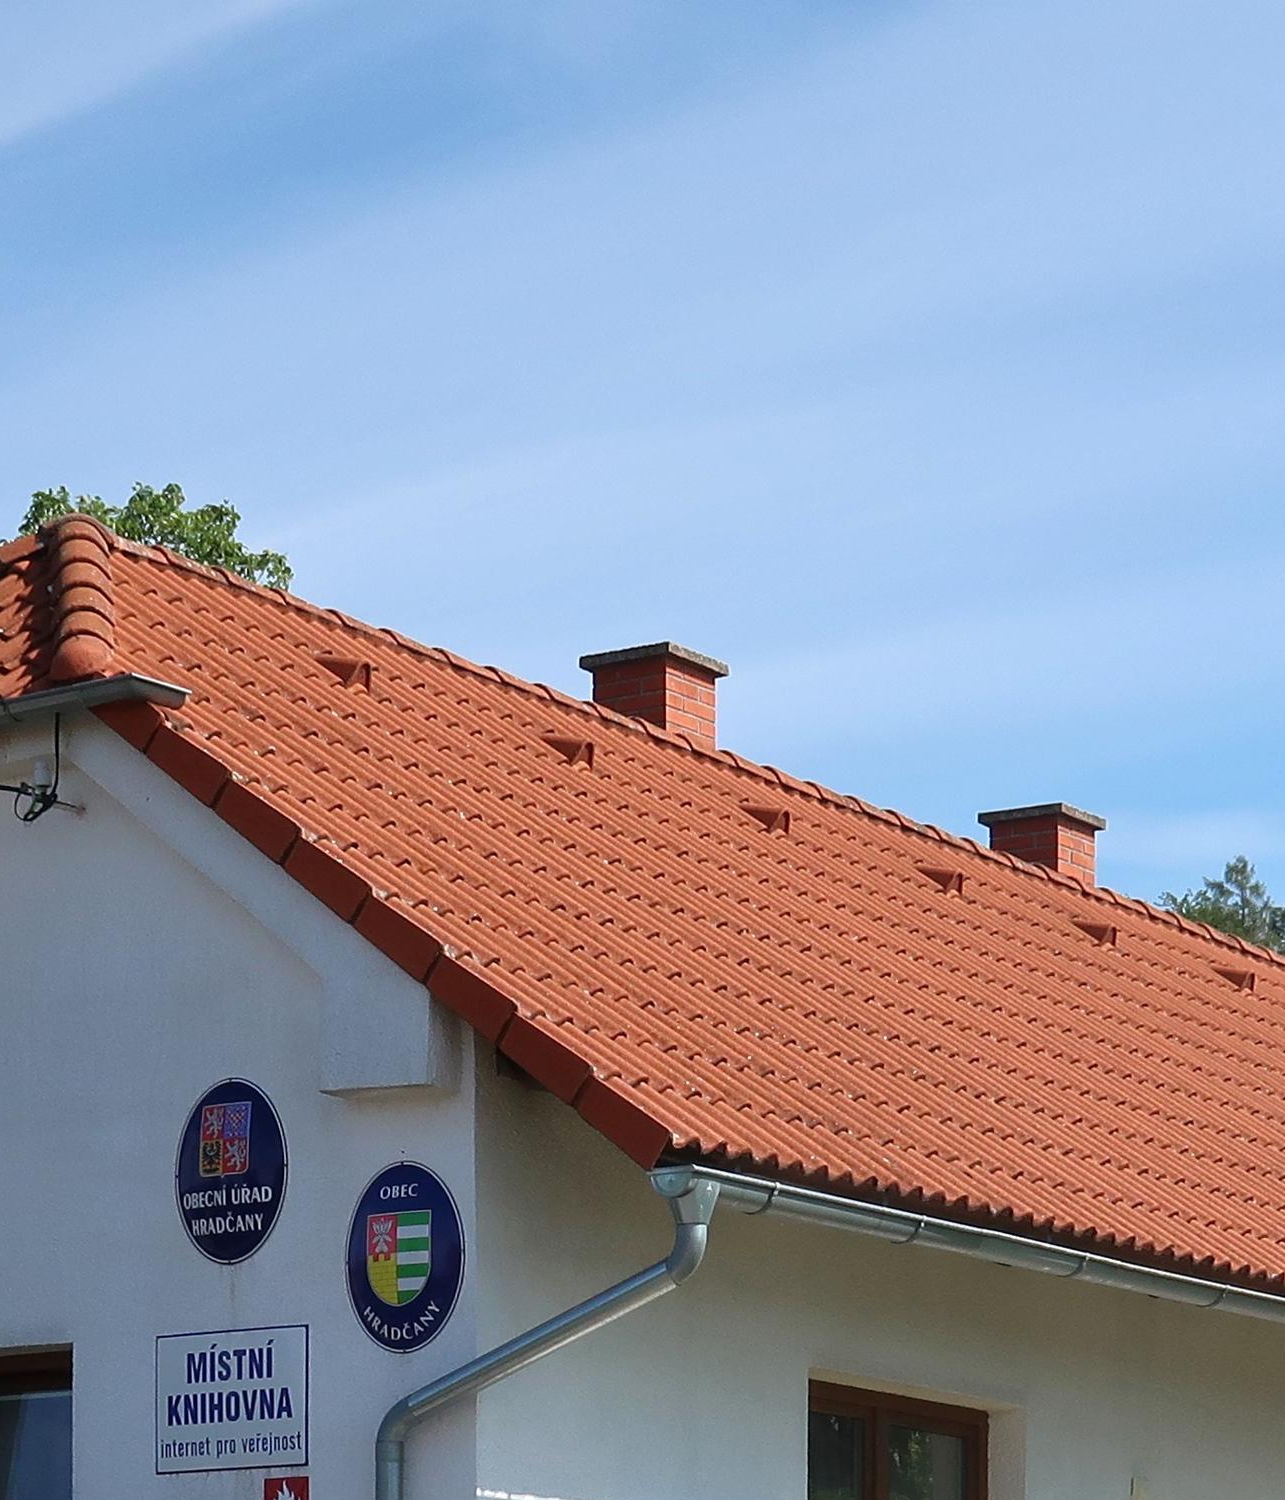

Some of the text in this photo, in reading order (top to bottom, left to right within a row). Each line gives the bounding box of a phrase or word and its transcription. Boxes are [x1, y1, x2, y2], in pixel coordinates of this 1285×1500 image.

[183, 1183, 273, 1209] OBECNÍ ÚŘAD
[380, 1183, 419, 1200] OBEC
[191, 1211, 264, 1236] HRADČANY
[363, 1301, 442, 1341] HRADČANY
[186, 1338, 275, 1384] MÍSTNÍ
[167, 1387, 293, 1426] KNIHOVNA
[160, 1431, 302, 1459] internet pro veřejnost
